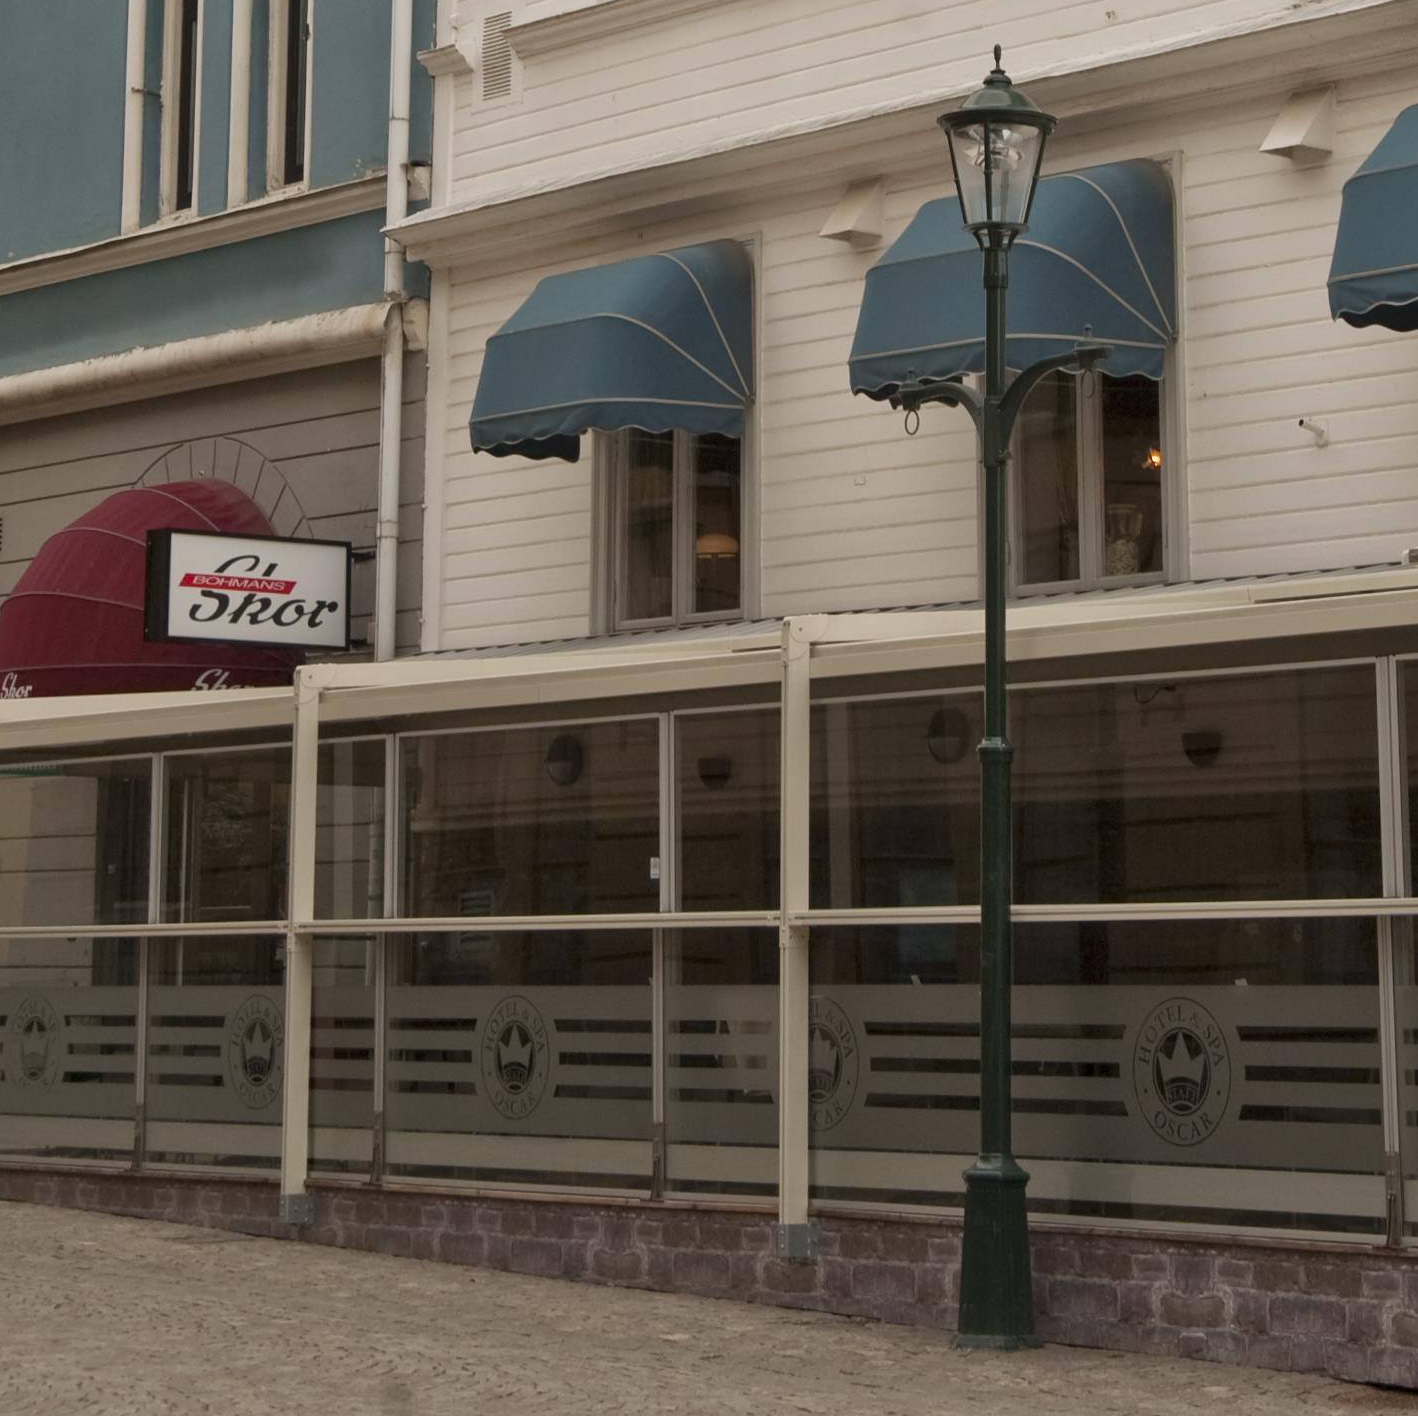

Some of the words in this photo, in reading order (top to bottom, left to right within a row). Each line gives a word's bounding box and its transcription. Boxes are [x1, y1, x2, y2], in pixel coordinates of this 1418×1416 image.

[188, 554, 339, 629] Skor
[192, 575, 286, 591] BOHMANS
[484, 1001, 521, 1052] HOTEL
[530, 1016, 546, 1055] SPA
[835, 1018, 854, 1059] SPA
[1137, 1004, 1187, 1066] HOTEL
[1189, 1011, 1203, 1030] &
[1202, 1023, 1226, 1068] SPA
[494, 1089, 537, 1114] OSCAR
[1153, 1110, 1214, 1142] OSCAR
